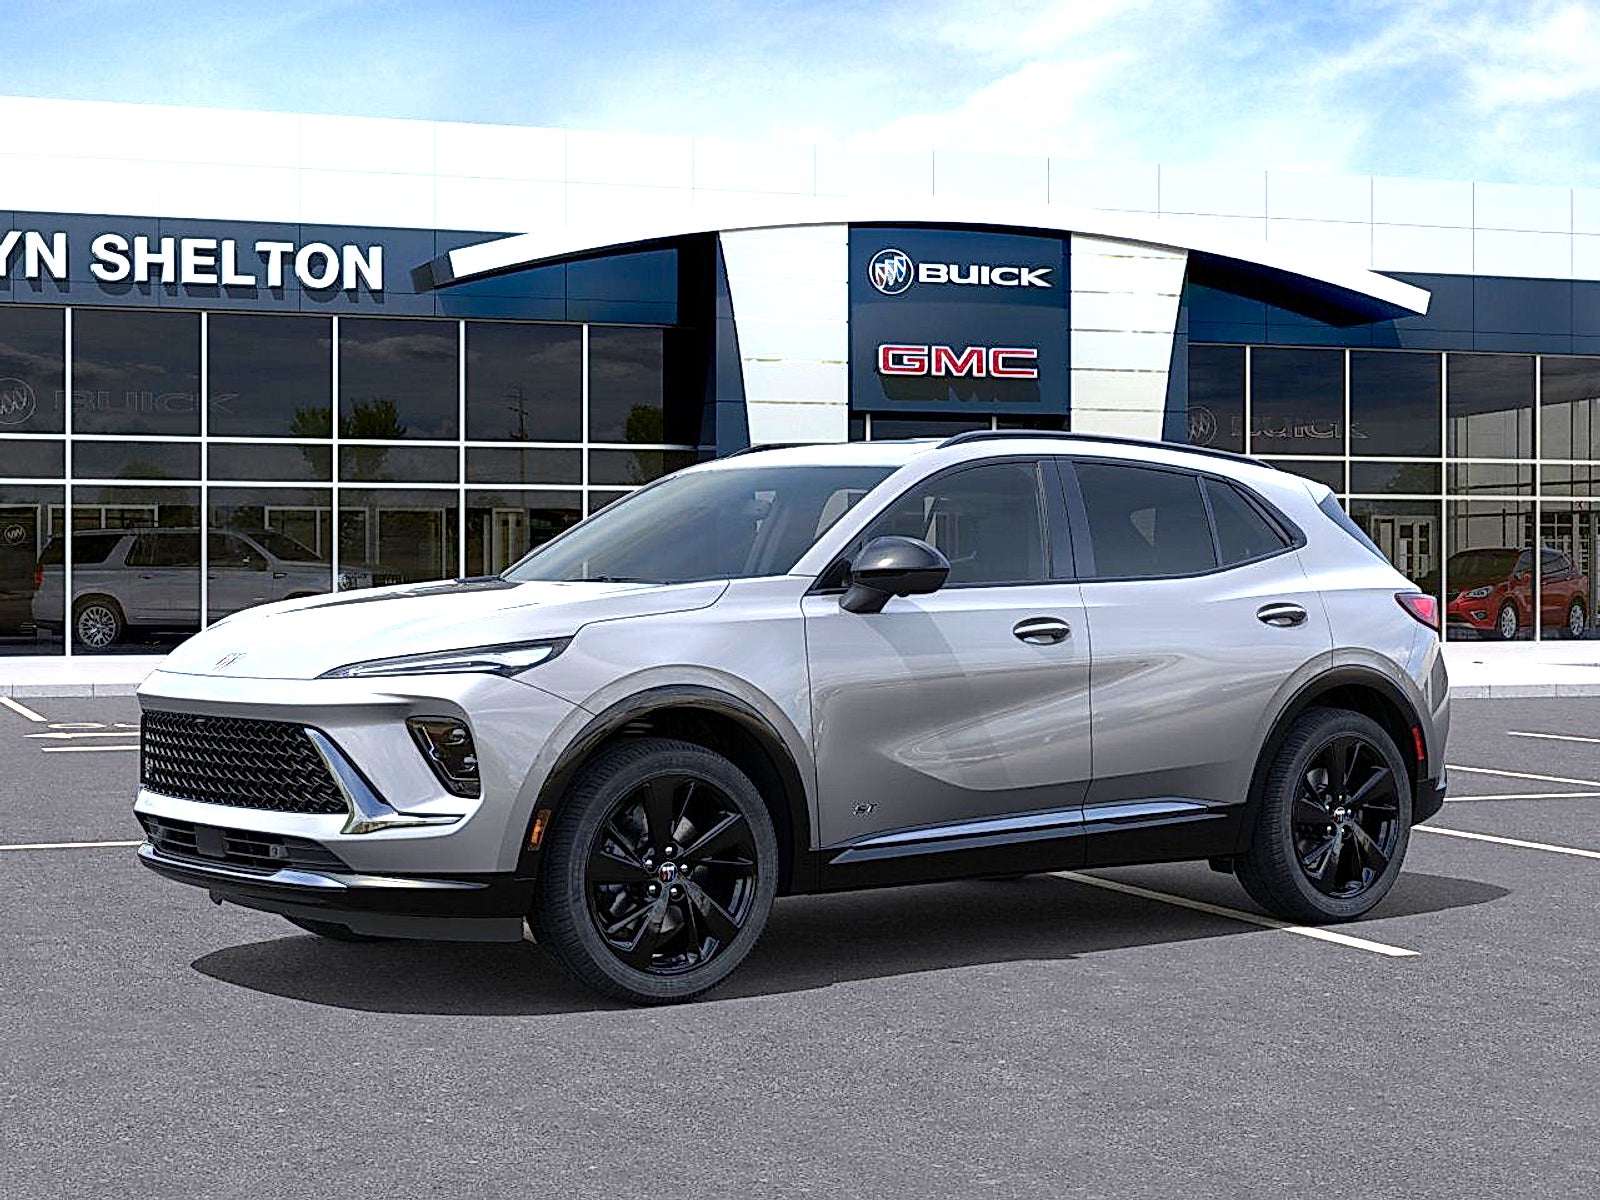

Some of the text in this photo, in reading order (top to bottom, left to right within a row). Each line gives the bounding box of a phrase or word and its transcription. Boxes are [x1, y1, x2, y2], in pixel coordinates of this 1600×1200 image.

[89, 232, 384, 291] SHELTON
[918, 262, 1053, 288] BUICK
[878, 344, 1038, 378] GMC
